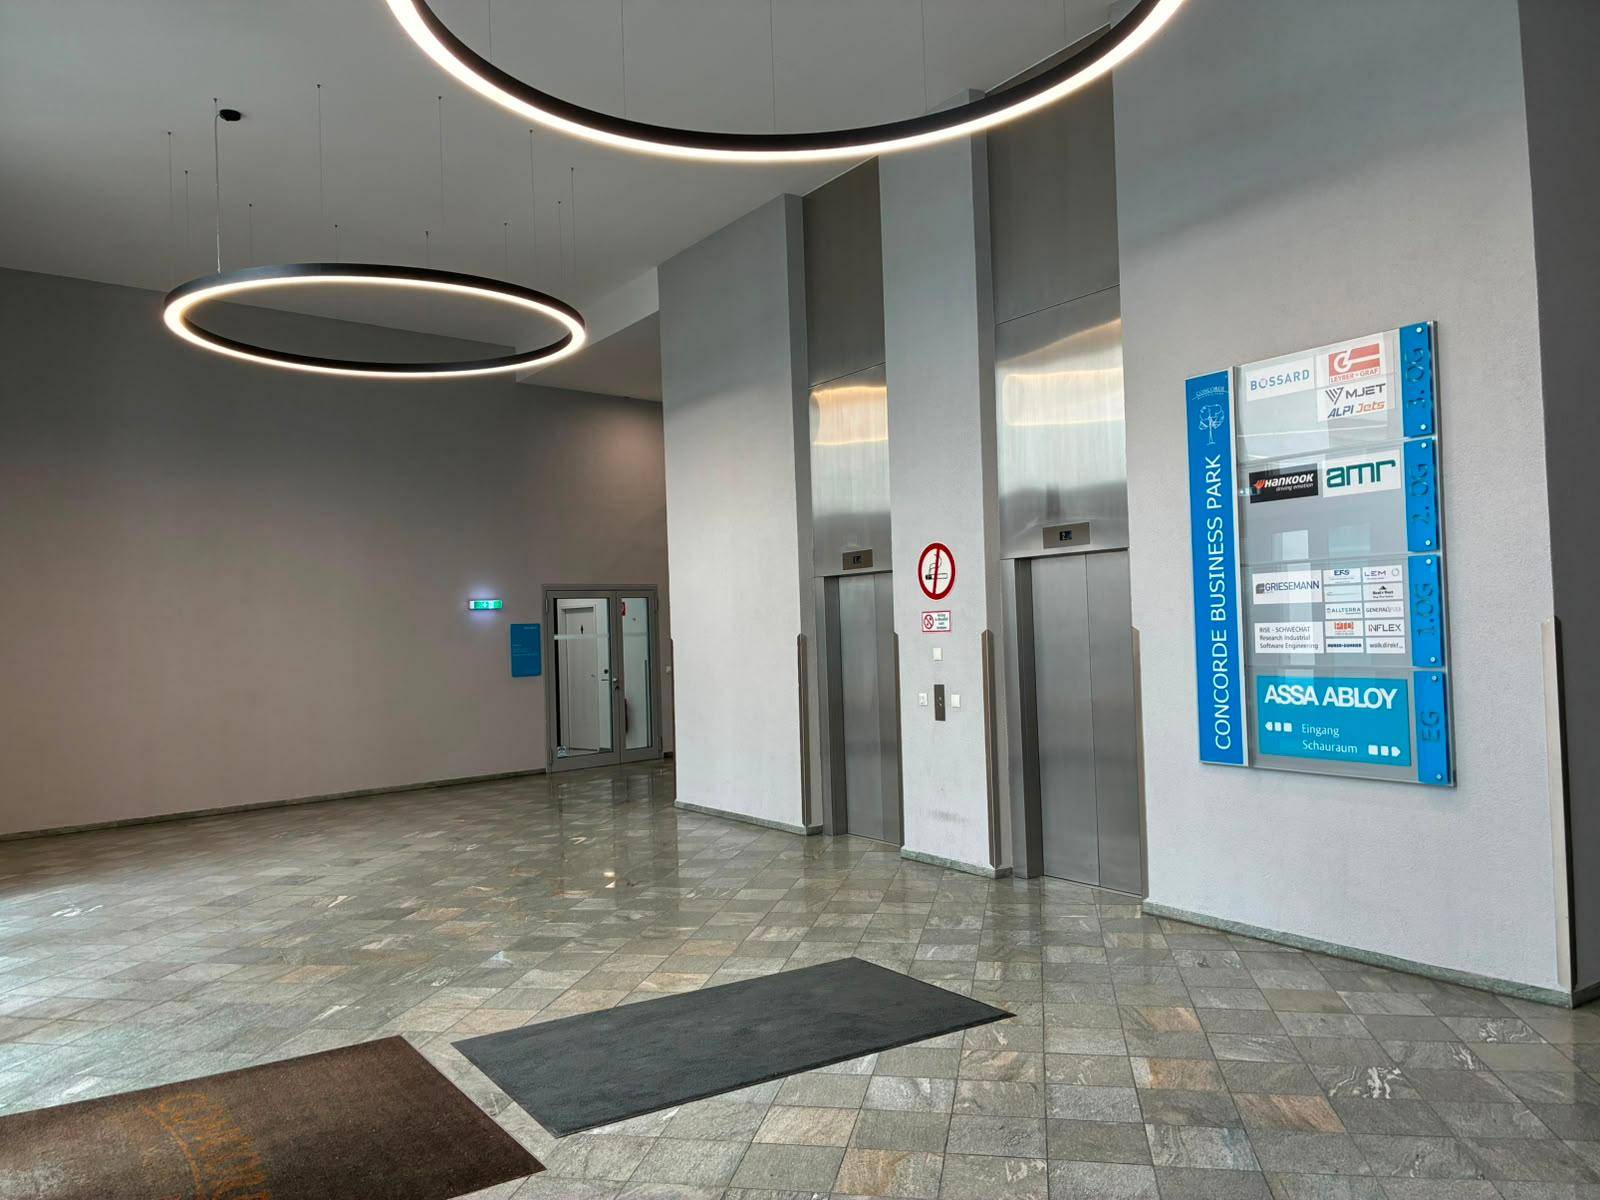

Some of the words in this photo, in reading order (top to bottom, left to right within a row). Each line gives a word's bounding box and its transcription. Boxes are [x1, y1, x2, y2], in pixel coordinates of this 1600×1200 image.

[1250, 369, 1310, 391] BOSSARD
[1359, 368, 1379, 377] GRAF
[1345, 383, 1386, 399] MJET
[1327, 405, 1354, 418] ALPI
[1356, 401, 1385, 413] Jets
[1206, 454, 1222, 510] PARK
[1326, 459, 1396, 488] amr
[1409, 463, 1430, 497] OG
[1276, 484, 1293, 493] driving
[1293, 482, 1314, 491] emotion
[1207, 516, 1227, 622] BUSINESS
[1264, 580, 1320, 592] GRIESEMANN
[1368, 623, 1402, 632] INFLEX
[1285, 642, 1319, 650] Engineering
[1210, 629, 1232, 750] CONCORDE
[1264, 684, 1319, 706] ASSA
[1321, 686, 1398, 709] ABLOY
[1301, 723, 1340, 737] Eingang
[1421, 711, 1441, 744] EG
[1302, 740, 1358, 754] Schauraum
